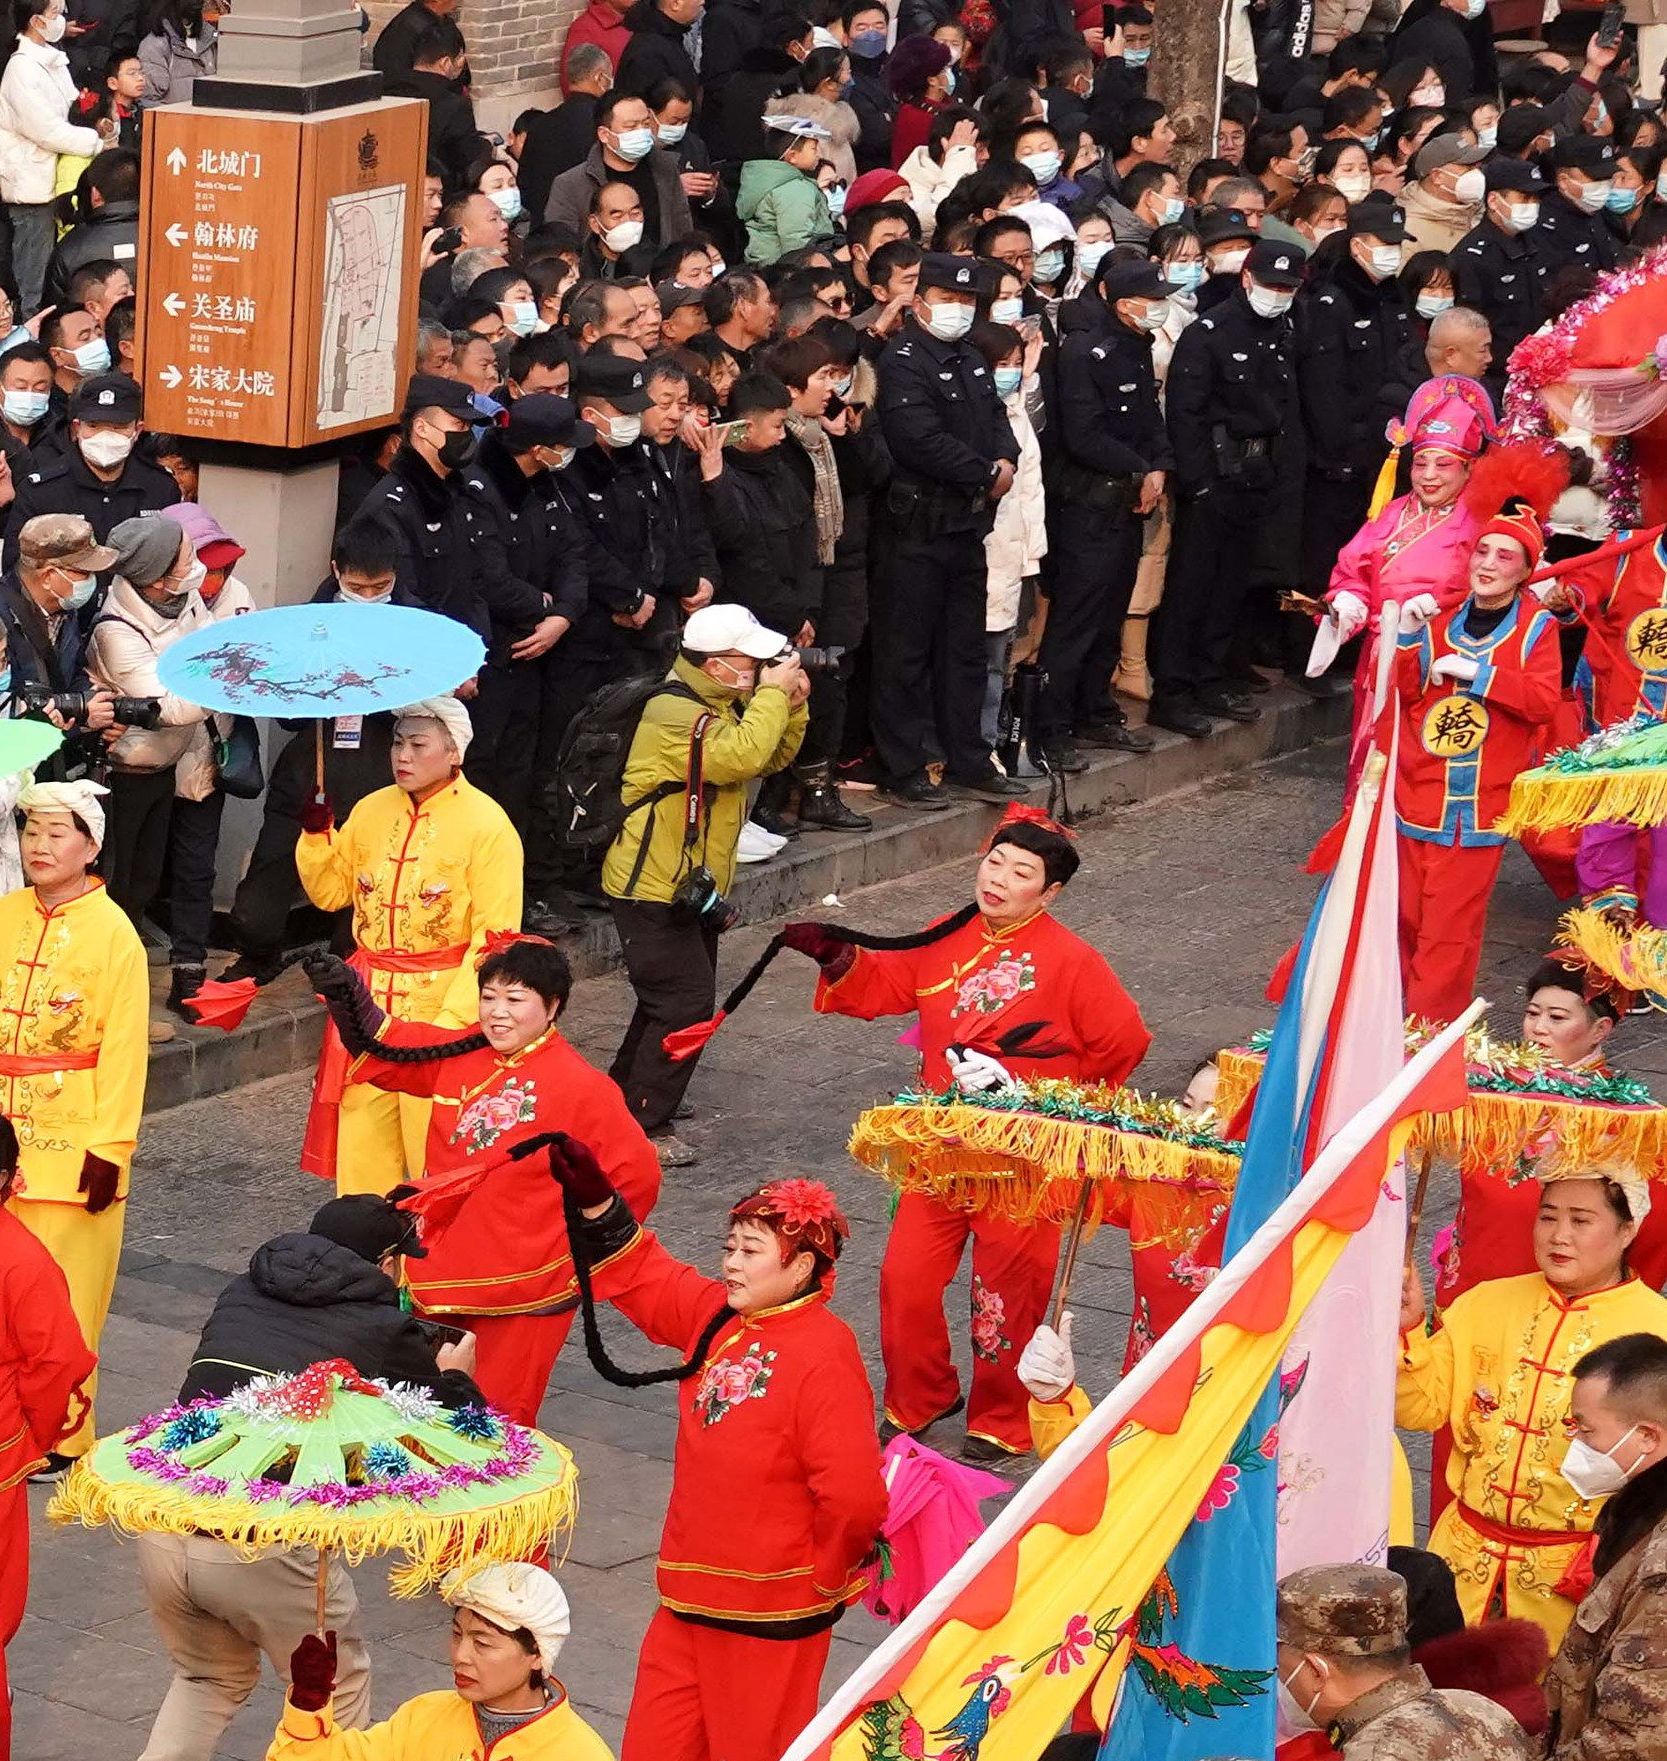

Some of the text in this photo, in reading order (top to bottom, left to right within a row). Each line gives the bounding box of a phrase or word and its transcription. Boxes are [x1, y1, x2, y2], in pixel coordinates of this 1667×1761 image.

[197, 149, 261, 178] 北城门
[195, 221, 259, 251] 翰林府
[192, 293, 257, 323] 关圣庙
[188, 364, 275, 397] 宋家大院
[1430, 702, 1486, 750] 轎
